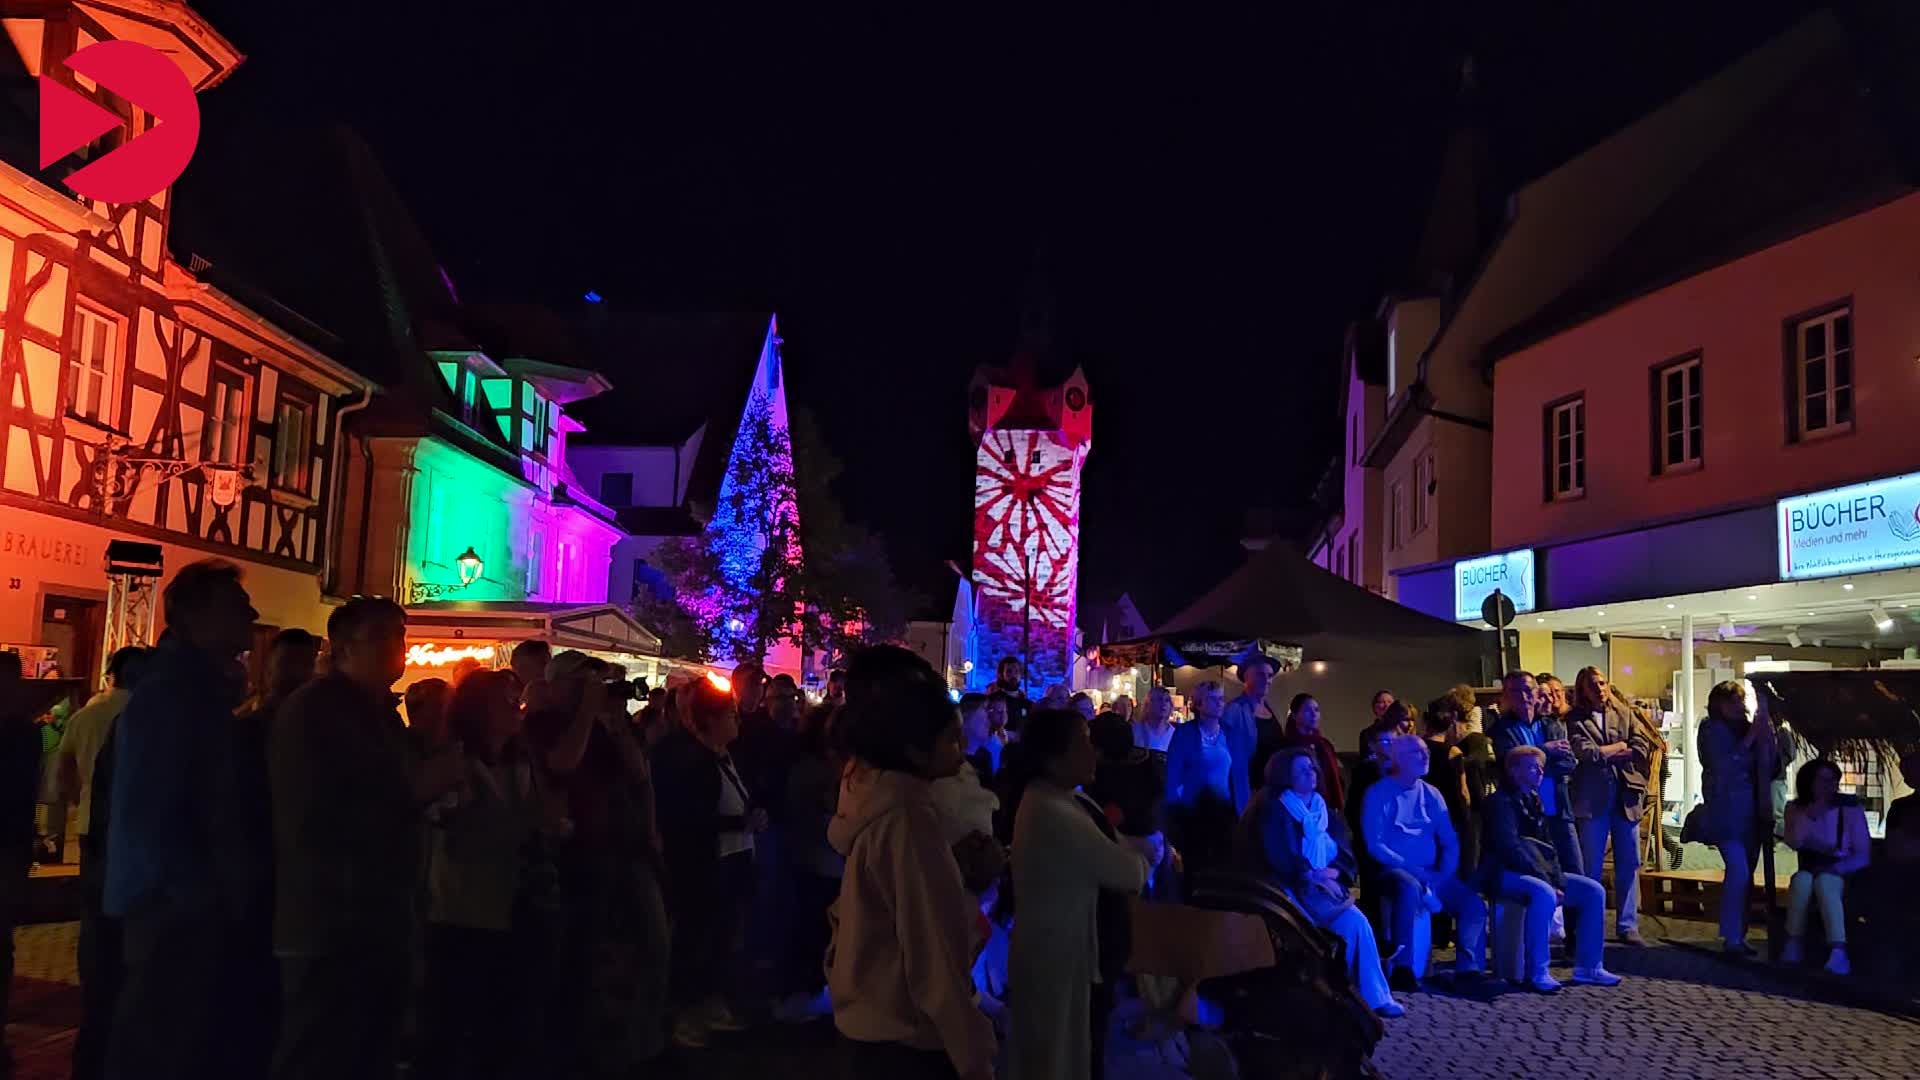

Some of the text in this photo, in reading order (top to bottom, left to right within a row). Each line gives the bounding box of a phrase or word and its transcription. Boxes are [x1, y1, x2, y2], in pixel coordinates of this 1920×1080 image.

[1792, 494, 1886, 532] BÜCHER
[4, 531, 89, 566] BRAUEREI
[1793, 529, 1868, 549] Medien und mehr
[9, 578, 21, 590] 33
[1463, 563, 1508, 586] BÜCHER
